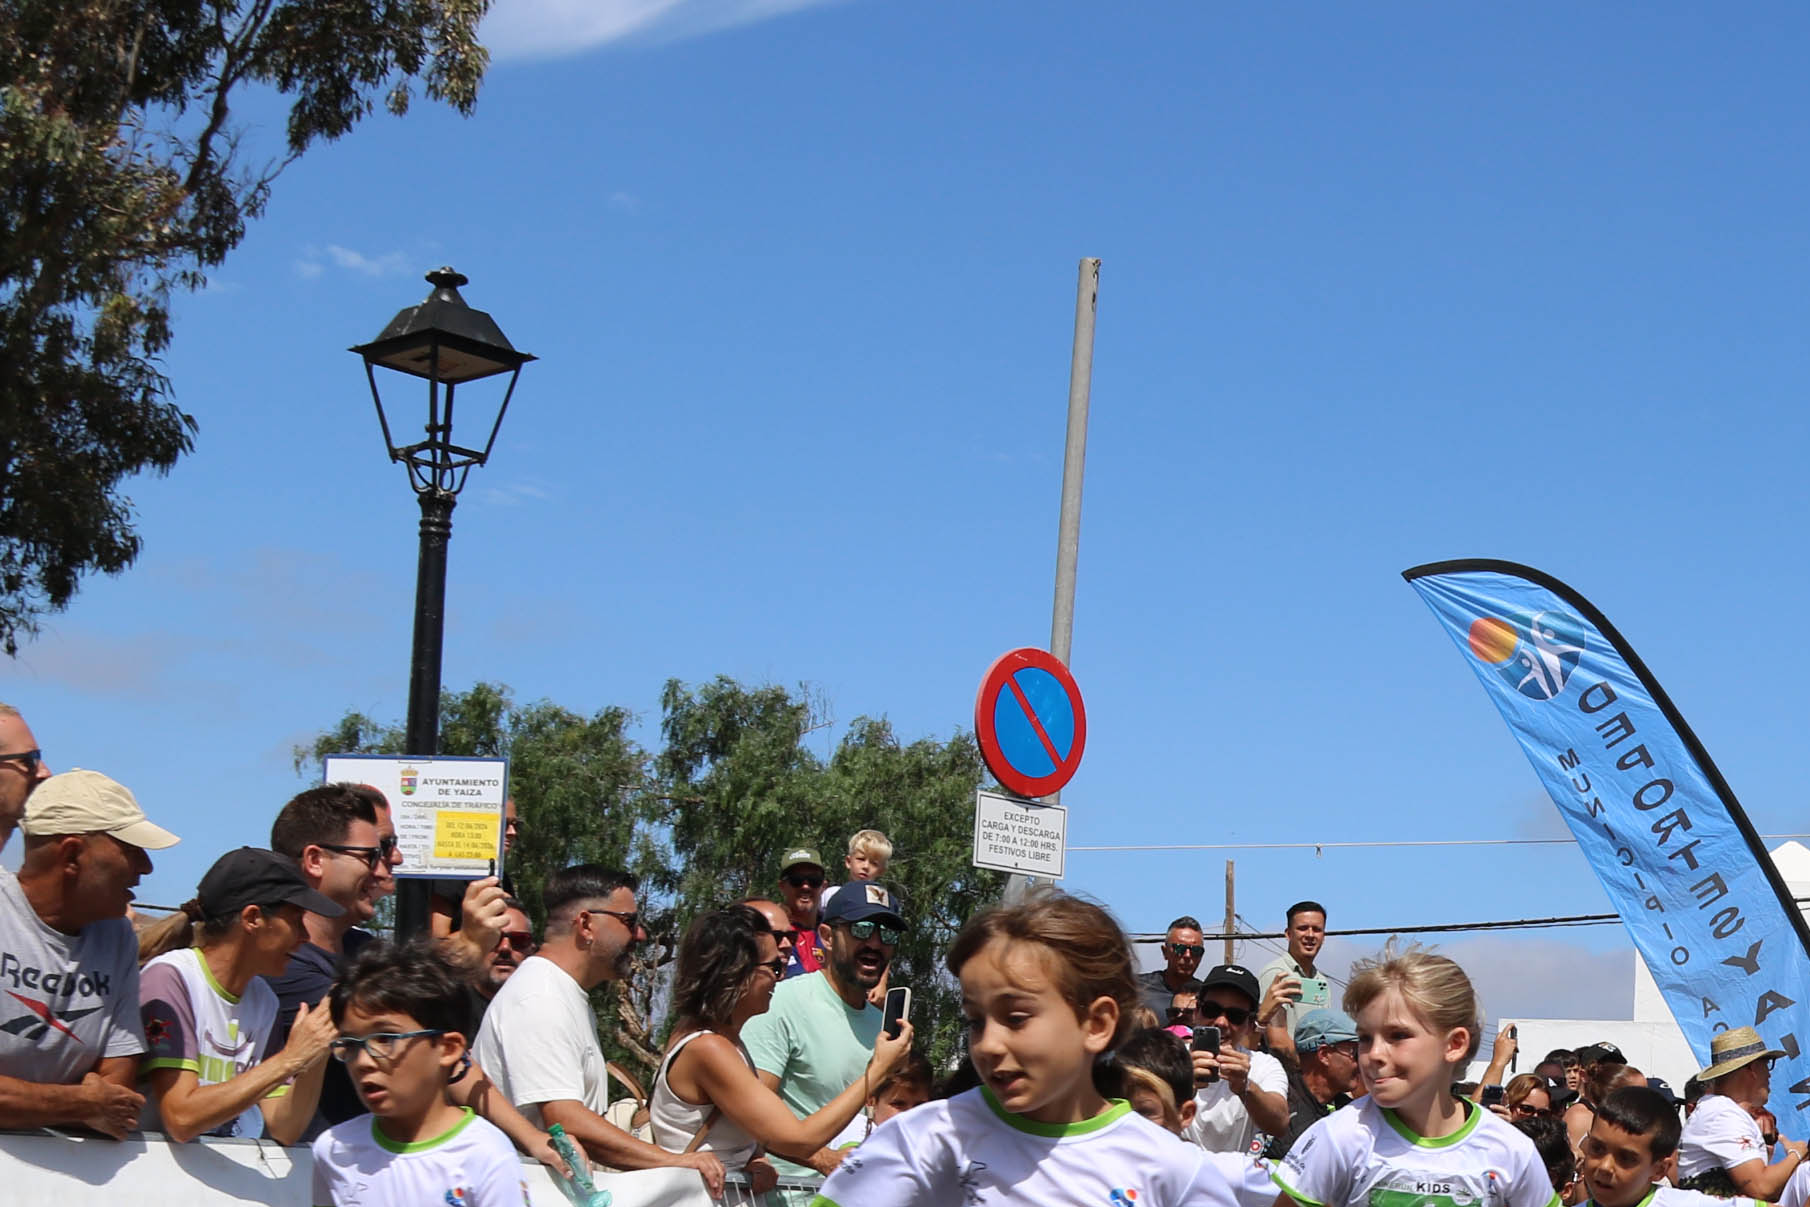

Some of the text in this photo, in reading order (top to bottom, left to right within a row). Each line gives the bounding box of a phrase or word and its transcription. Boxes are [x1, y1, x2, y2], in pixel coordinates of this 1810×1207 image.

[422, 778, 499, 787] AYUNTAMIENTO
[438, 788, 482, 797] DE YAIZA
[1004, 811, 1040, 825] EXCEPTO
[982, 819, 1060, 840] CARGA Y DESCARGA
[983, 831, 1057, 852] DE 7:00 A 12:00 HRS.
[989, 844, 1051, 862] FESTIVOS LIBRE
[1, 952, 110, 997] Reebok
[1416, 1181, 1450, 1194] KIDS
